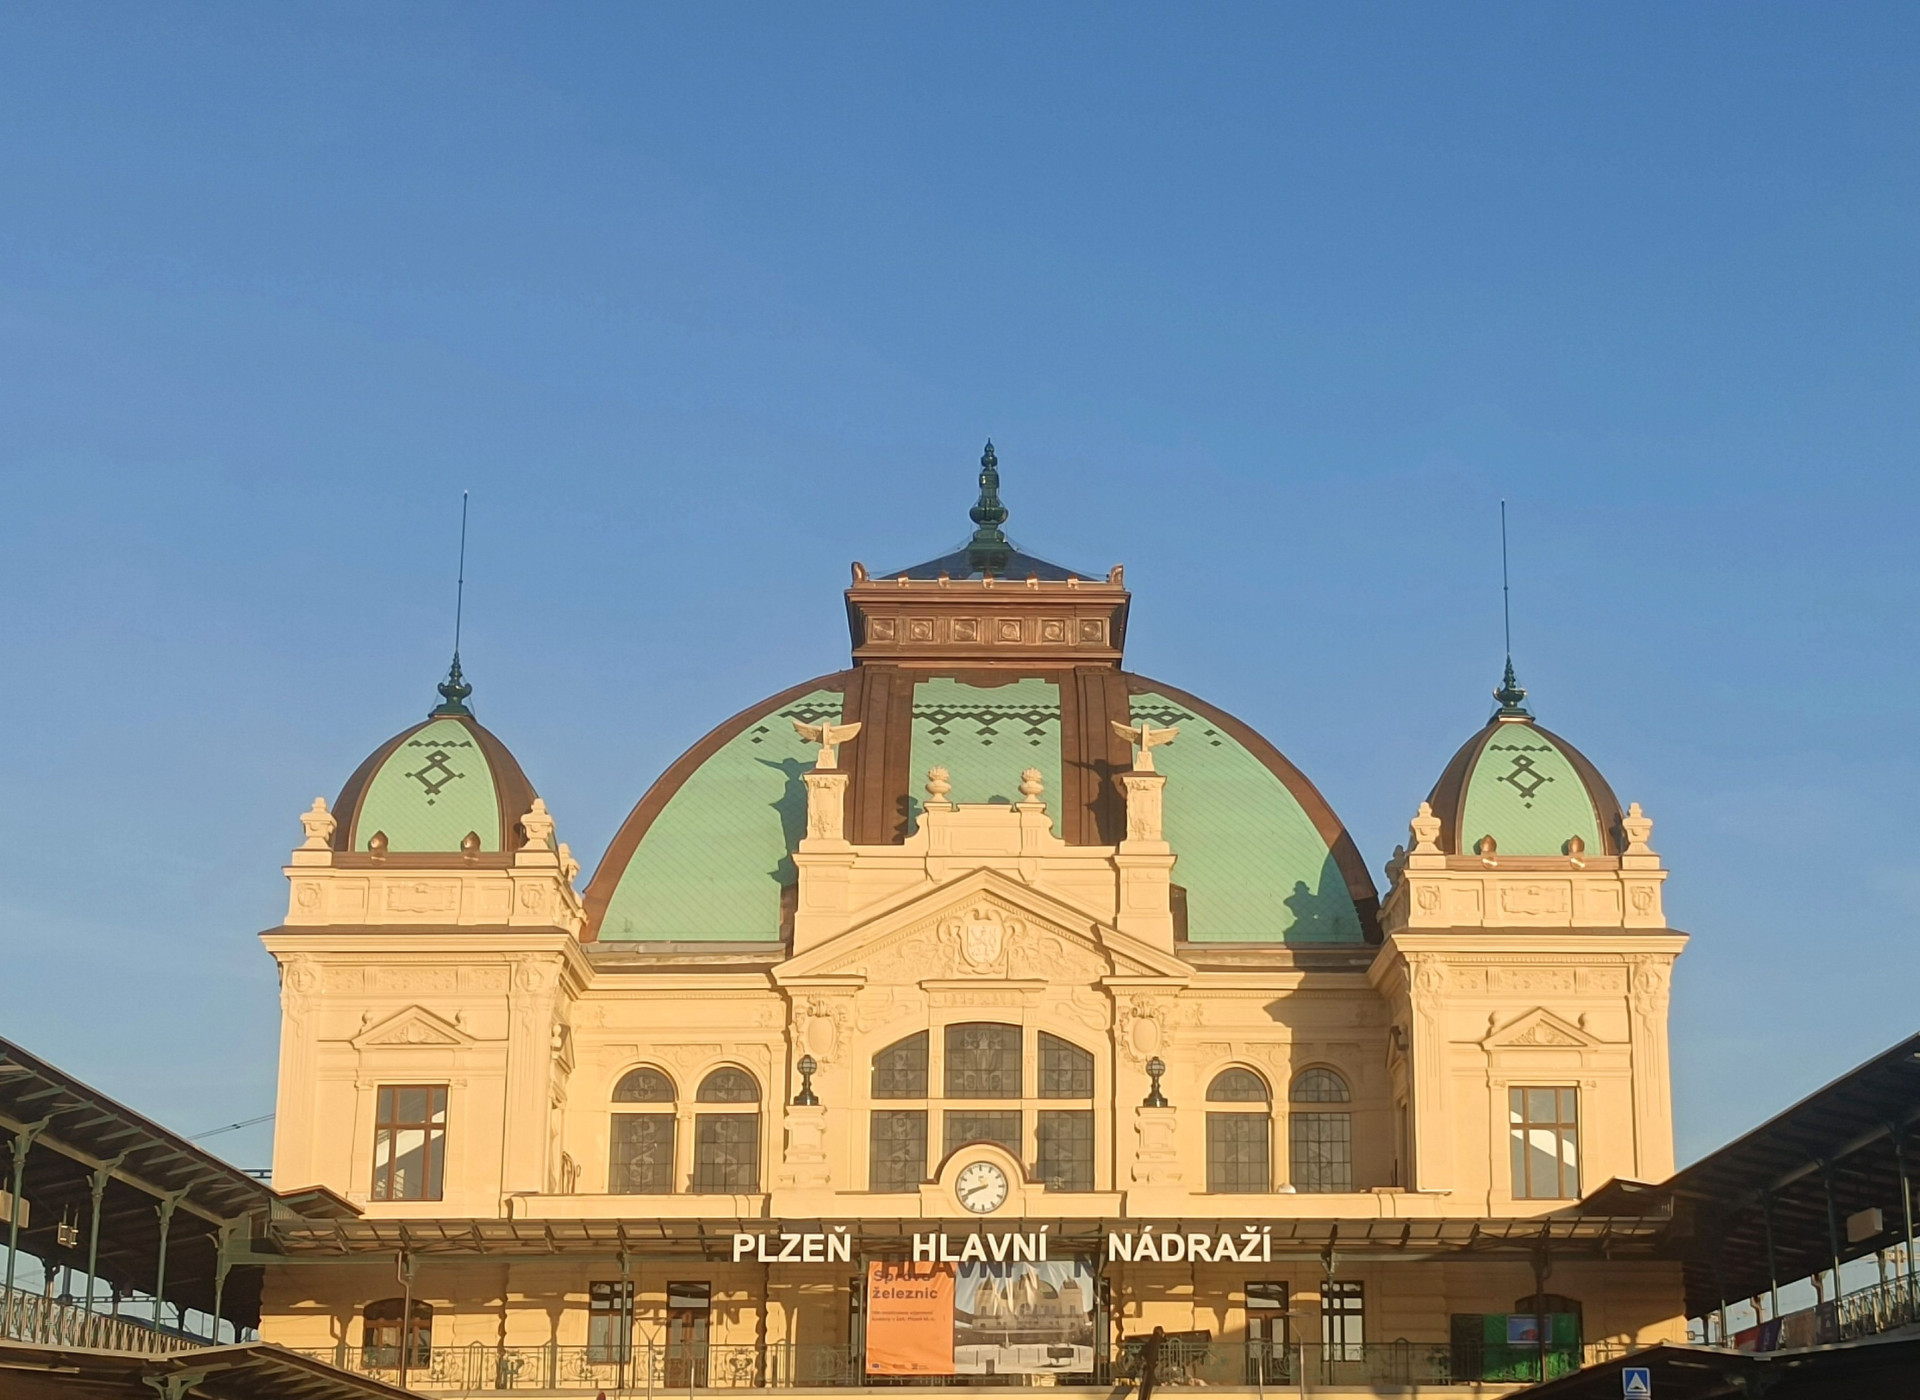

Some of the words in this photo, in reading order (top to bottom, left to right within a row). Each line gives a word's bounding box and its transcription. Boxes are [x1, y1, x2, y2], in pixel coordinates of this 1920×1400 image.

[733, 1226, 850, 1262] PLZEŇ
[912, 1225, 1049, 1262] HLAVNÍ
[1108, 1225, 1272, 1262] NÁDRAŽÍ
[872, 1286, 938, 1299] železnic
